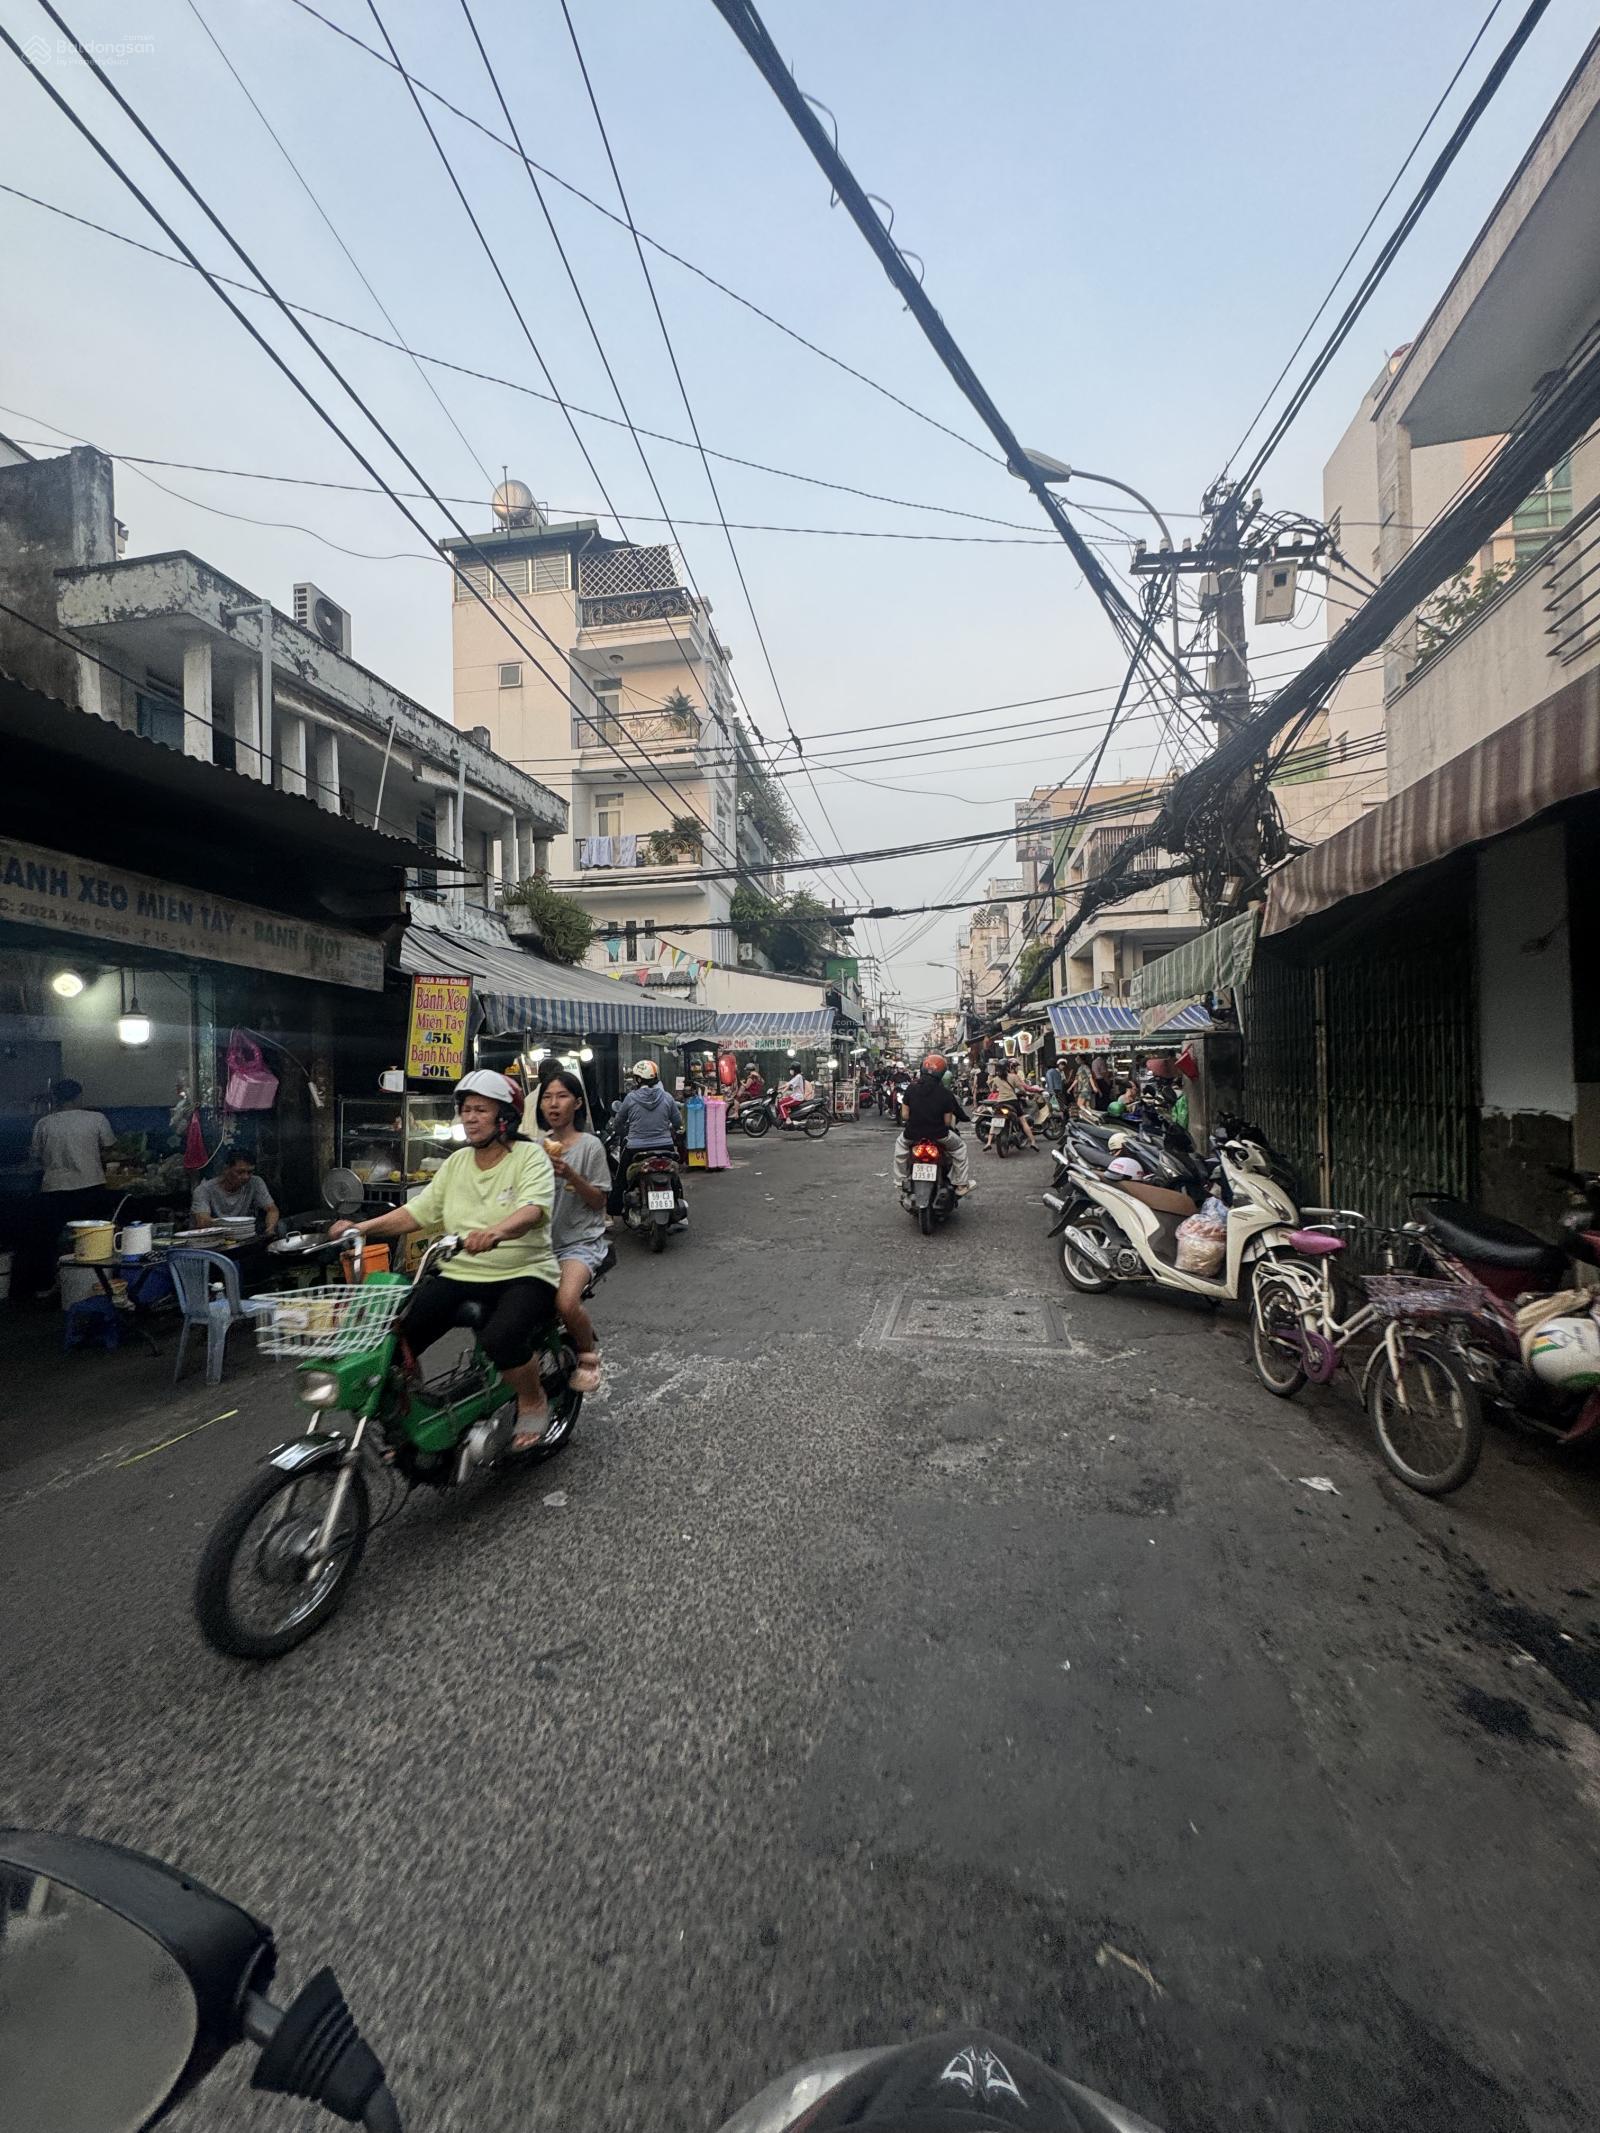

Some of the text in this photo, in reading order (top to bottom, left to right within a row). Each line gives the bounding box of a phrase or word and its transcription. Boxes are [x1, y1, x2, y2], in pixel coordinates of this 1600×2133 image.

[426, 1032, 453, 1044] 45K
[1060, 1038, 1090, 1051] 179
[422, 1064, 450, 1077] 50K
